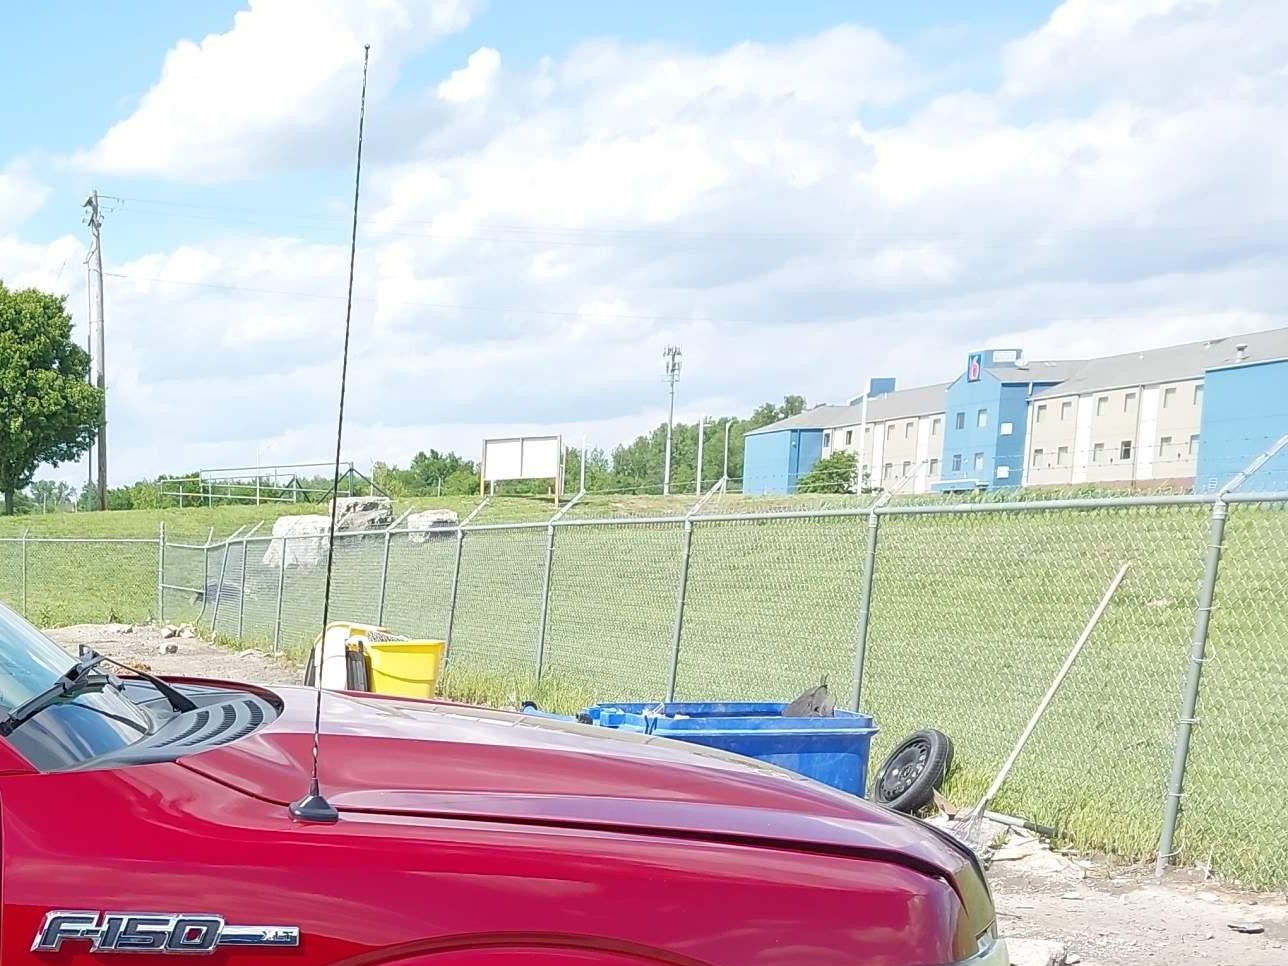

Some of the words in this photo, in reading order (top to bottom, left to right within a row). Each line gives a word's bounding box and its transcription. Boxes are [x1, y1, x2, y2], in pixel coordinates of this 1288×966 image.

[968, 354, 980, 380] 6
[30, 910, 225, 954] F-150
[262, 930, 294, 942] XLT
